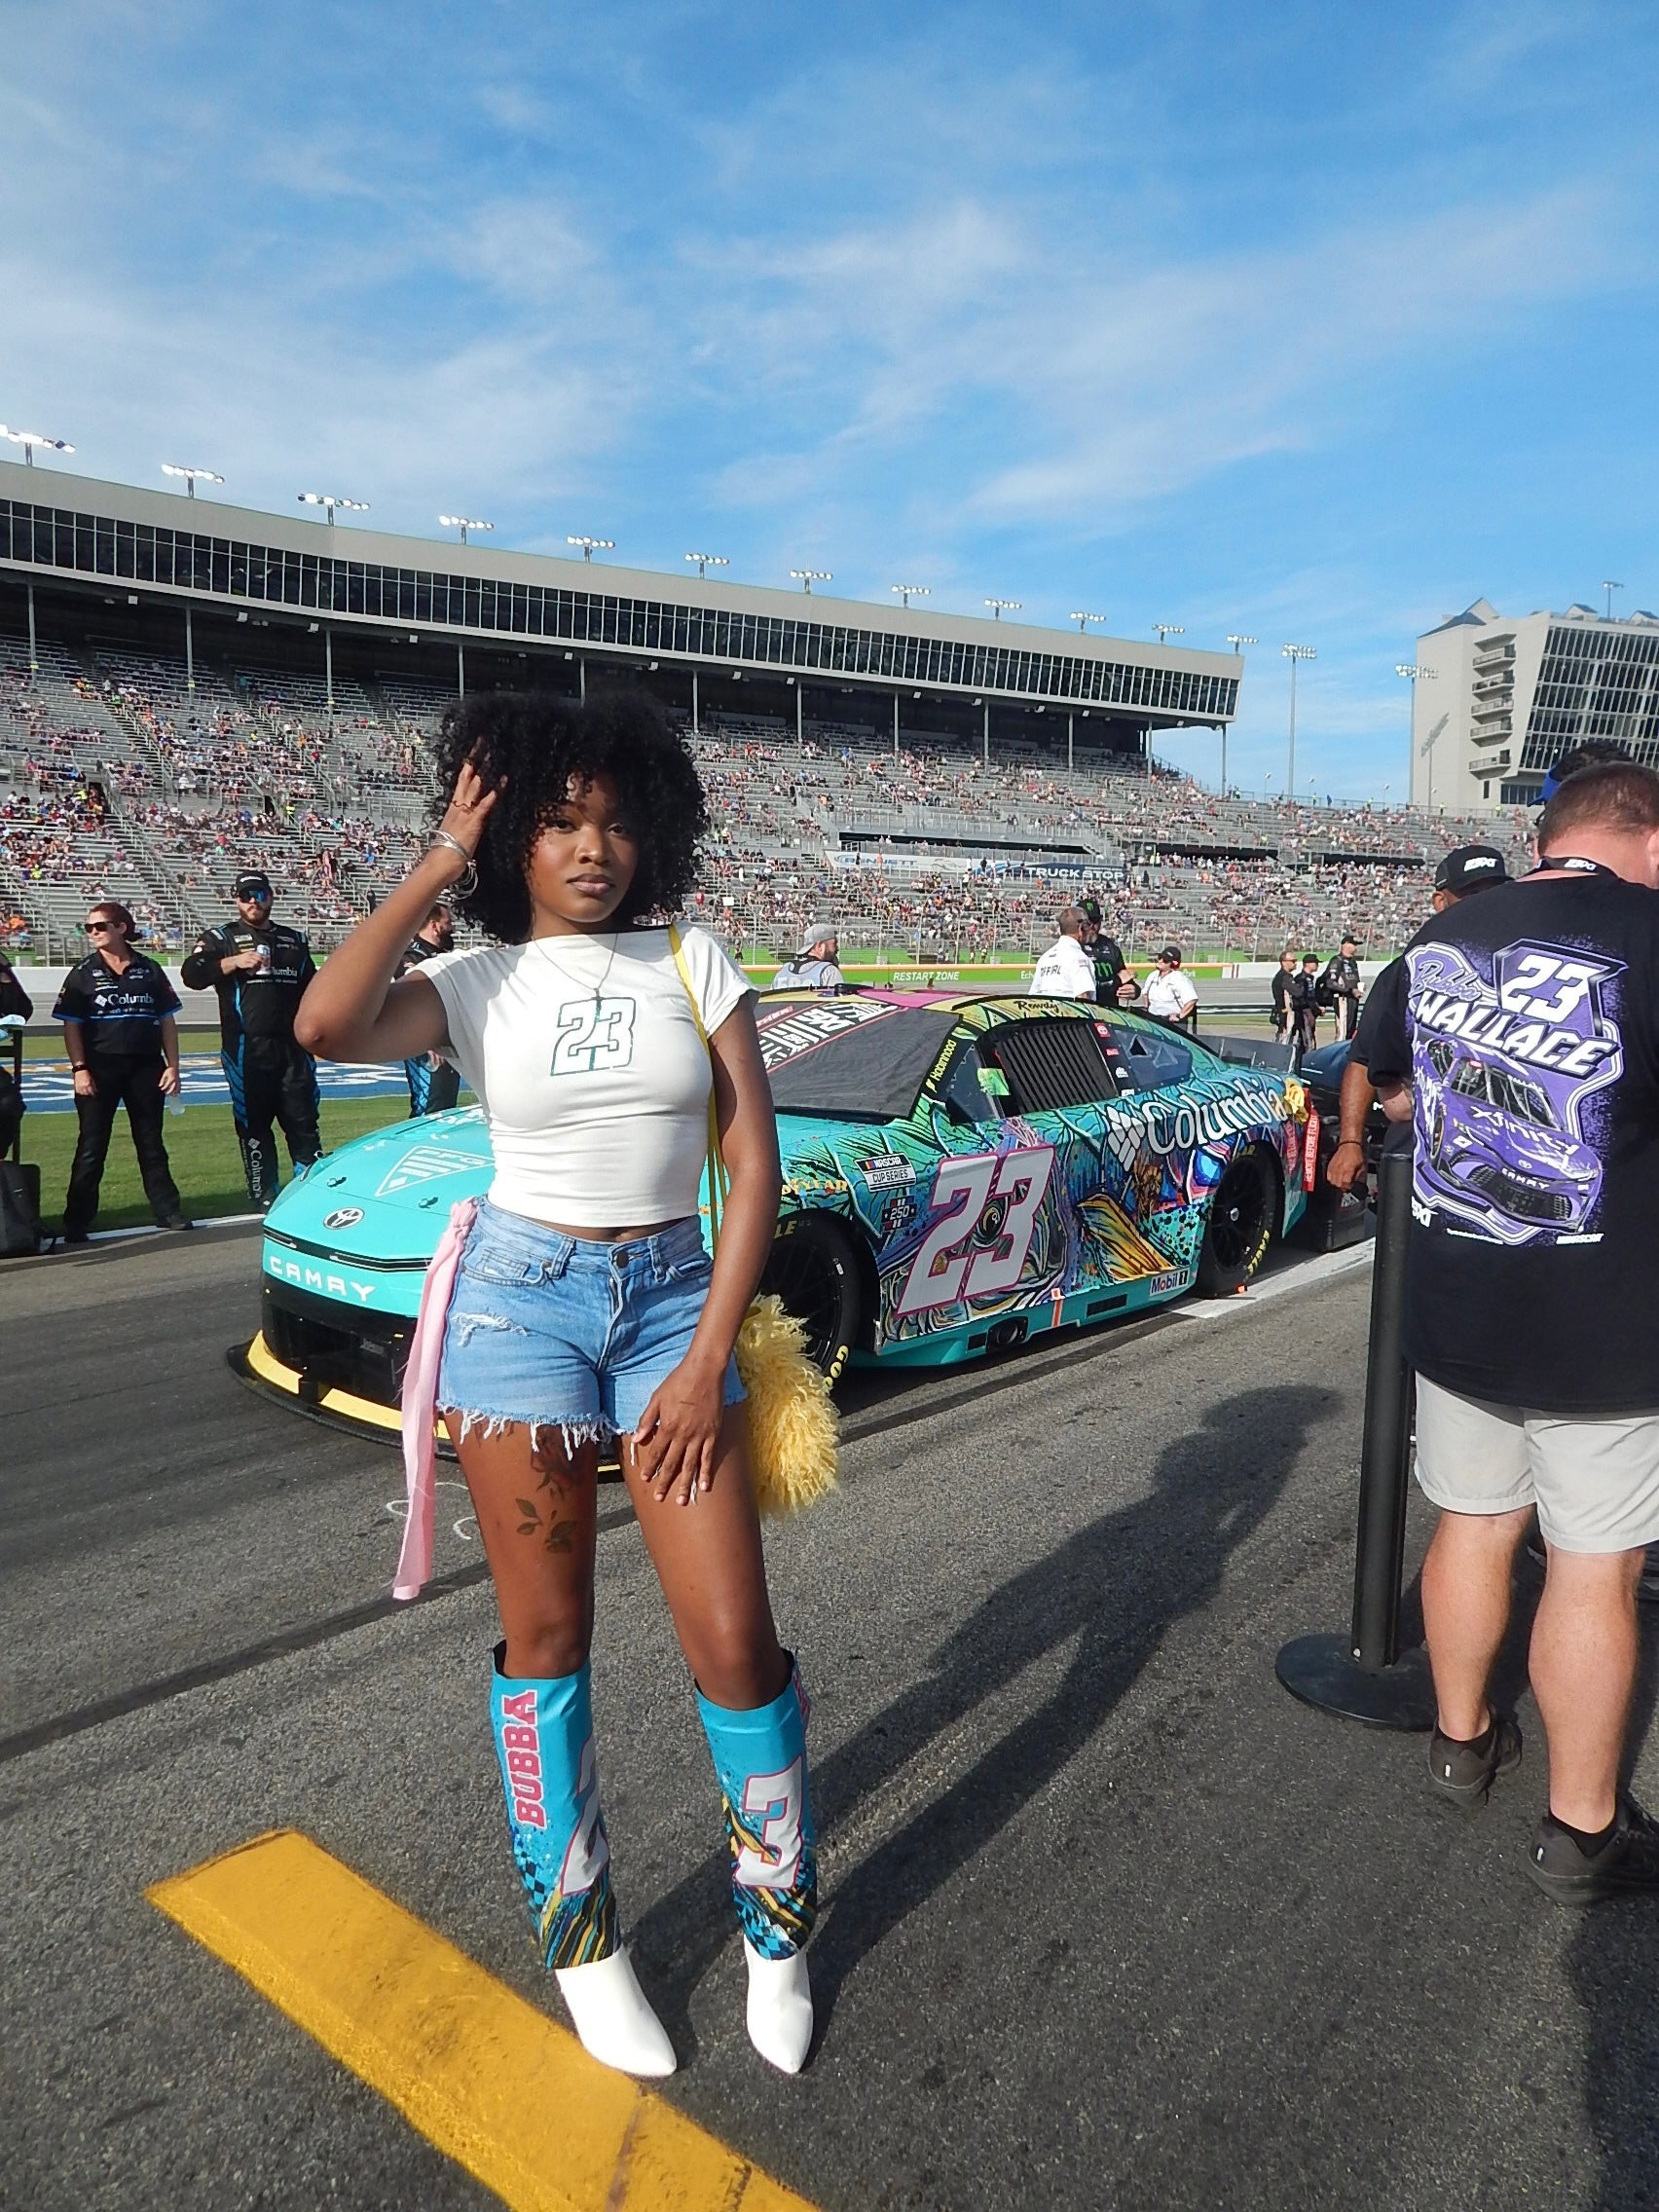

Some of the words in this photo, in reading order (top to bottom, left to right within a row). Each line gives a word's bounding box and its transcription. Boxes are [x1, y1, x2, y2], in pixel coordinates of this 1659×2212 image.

[1025, 866, 1081, 878] TRUCK
[1083, 869, 1124, 880] STOP
[893, 972, 935, 981] RESTART
[936, 972, 960, 980] ZONE
[1501, 954, 1592, 1023] 23
[549, 996, 637, 1077] 23
[1415, 990, 1612, 1076] WALLACE
[1141, 1077, 1289, 1155] Columbia
[872, 1171, 885, 1183] CUP
[886, 1169, 908, 1181] SERIES
[873, 1157, 903, 1168] NASCAR
[890, 1204, 910, 1221] 250
[896, 1144, 1056, 1317] 23
[1151, 1272, 1178, 1294] Mobil
[500, 1688, 547, 1830] BUBBA
[732, 1755, 804, 1889] 3
